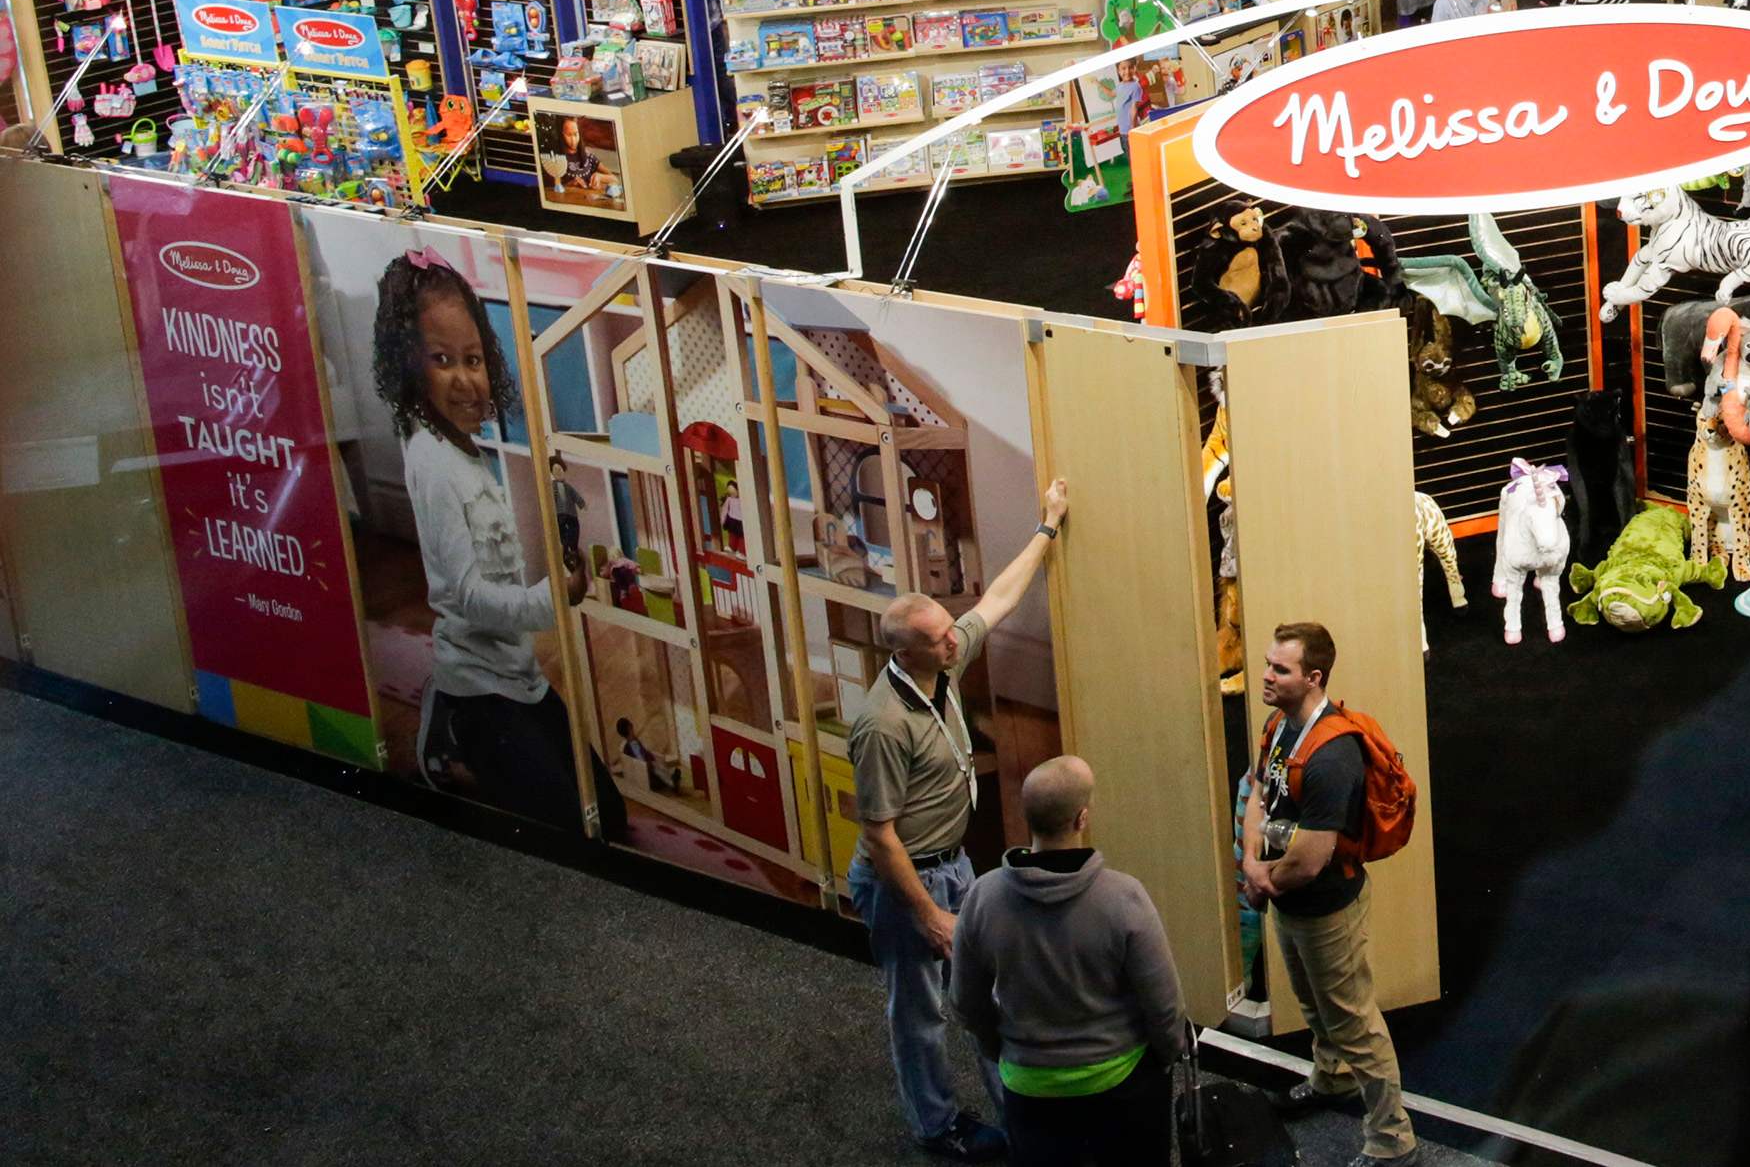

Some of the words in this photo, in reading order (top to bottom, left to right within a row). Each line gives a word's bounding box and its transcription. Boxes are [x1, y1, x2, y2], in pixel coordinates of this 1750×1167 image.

[199, 10, 228, 27] Melissa
[234, 15, 254, 31] Doug
[299, 24, 330, 40] Melissa
[339, 29, 360, 46] Doug
[1273, 87, 1568, 178] Melissa
[1595, 71, 1628, 125] &
[169, 250, 212, 271] Melissa
[223, 259, 249, 284] Doug
[162, 308, 281, 373] KINDNESS
[200, 372, 264, 419] isn't
[227, 472, 269, 513] it's
[205, 516, 311, 581] LEARNED.
[247, 593, 270, 619] Mary
[271, 597, 303, 623] Gordon
